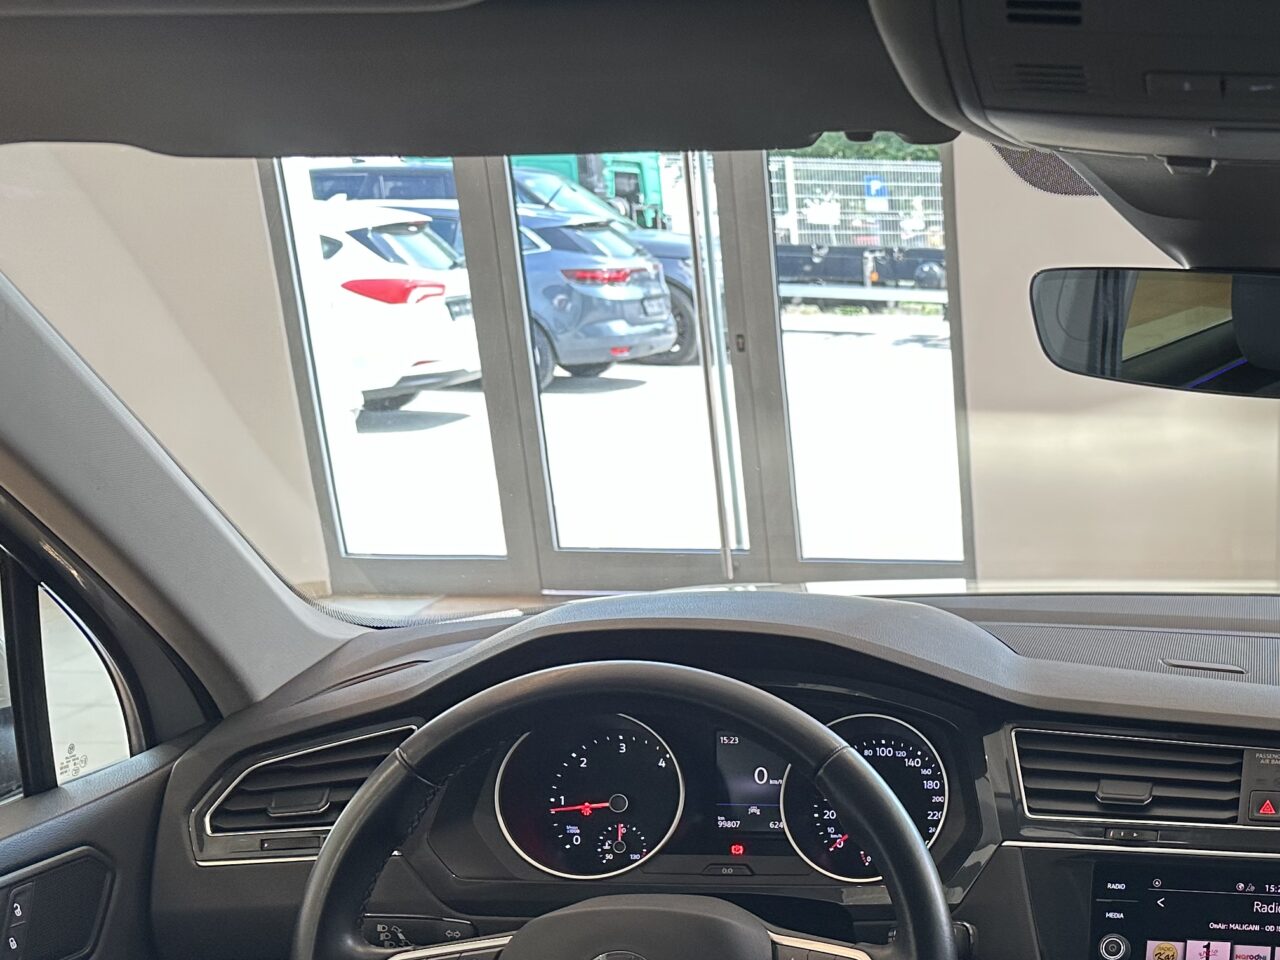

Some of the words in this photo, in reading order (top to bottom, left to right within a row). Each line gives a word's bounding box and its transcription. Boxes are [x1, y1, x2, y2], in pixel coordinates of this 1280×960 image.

[720, 736, 739, 744] 15:23
[619, 743, 626, 753] 3
[876, 747, 894, 757] 100
[895, 750, 907, 758] 120
[580, 757, 587, 768] 2
[658, 758, 666, 768] 4
[904, 758, 921, 767] 140
[754, 766, 768, 785] 0
[923, 780, 940, 790] 180
[560, 795, 565, 806] 1
[823, 810, 836, 819] 20
[718, 820, 740, 828] 99807
[573, 835, 581, 845] 0
[1107, 882, 1126, 890] RADIO
